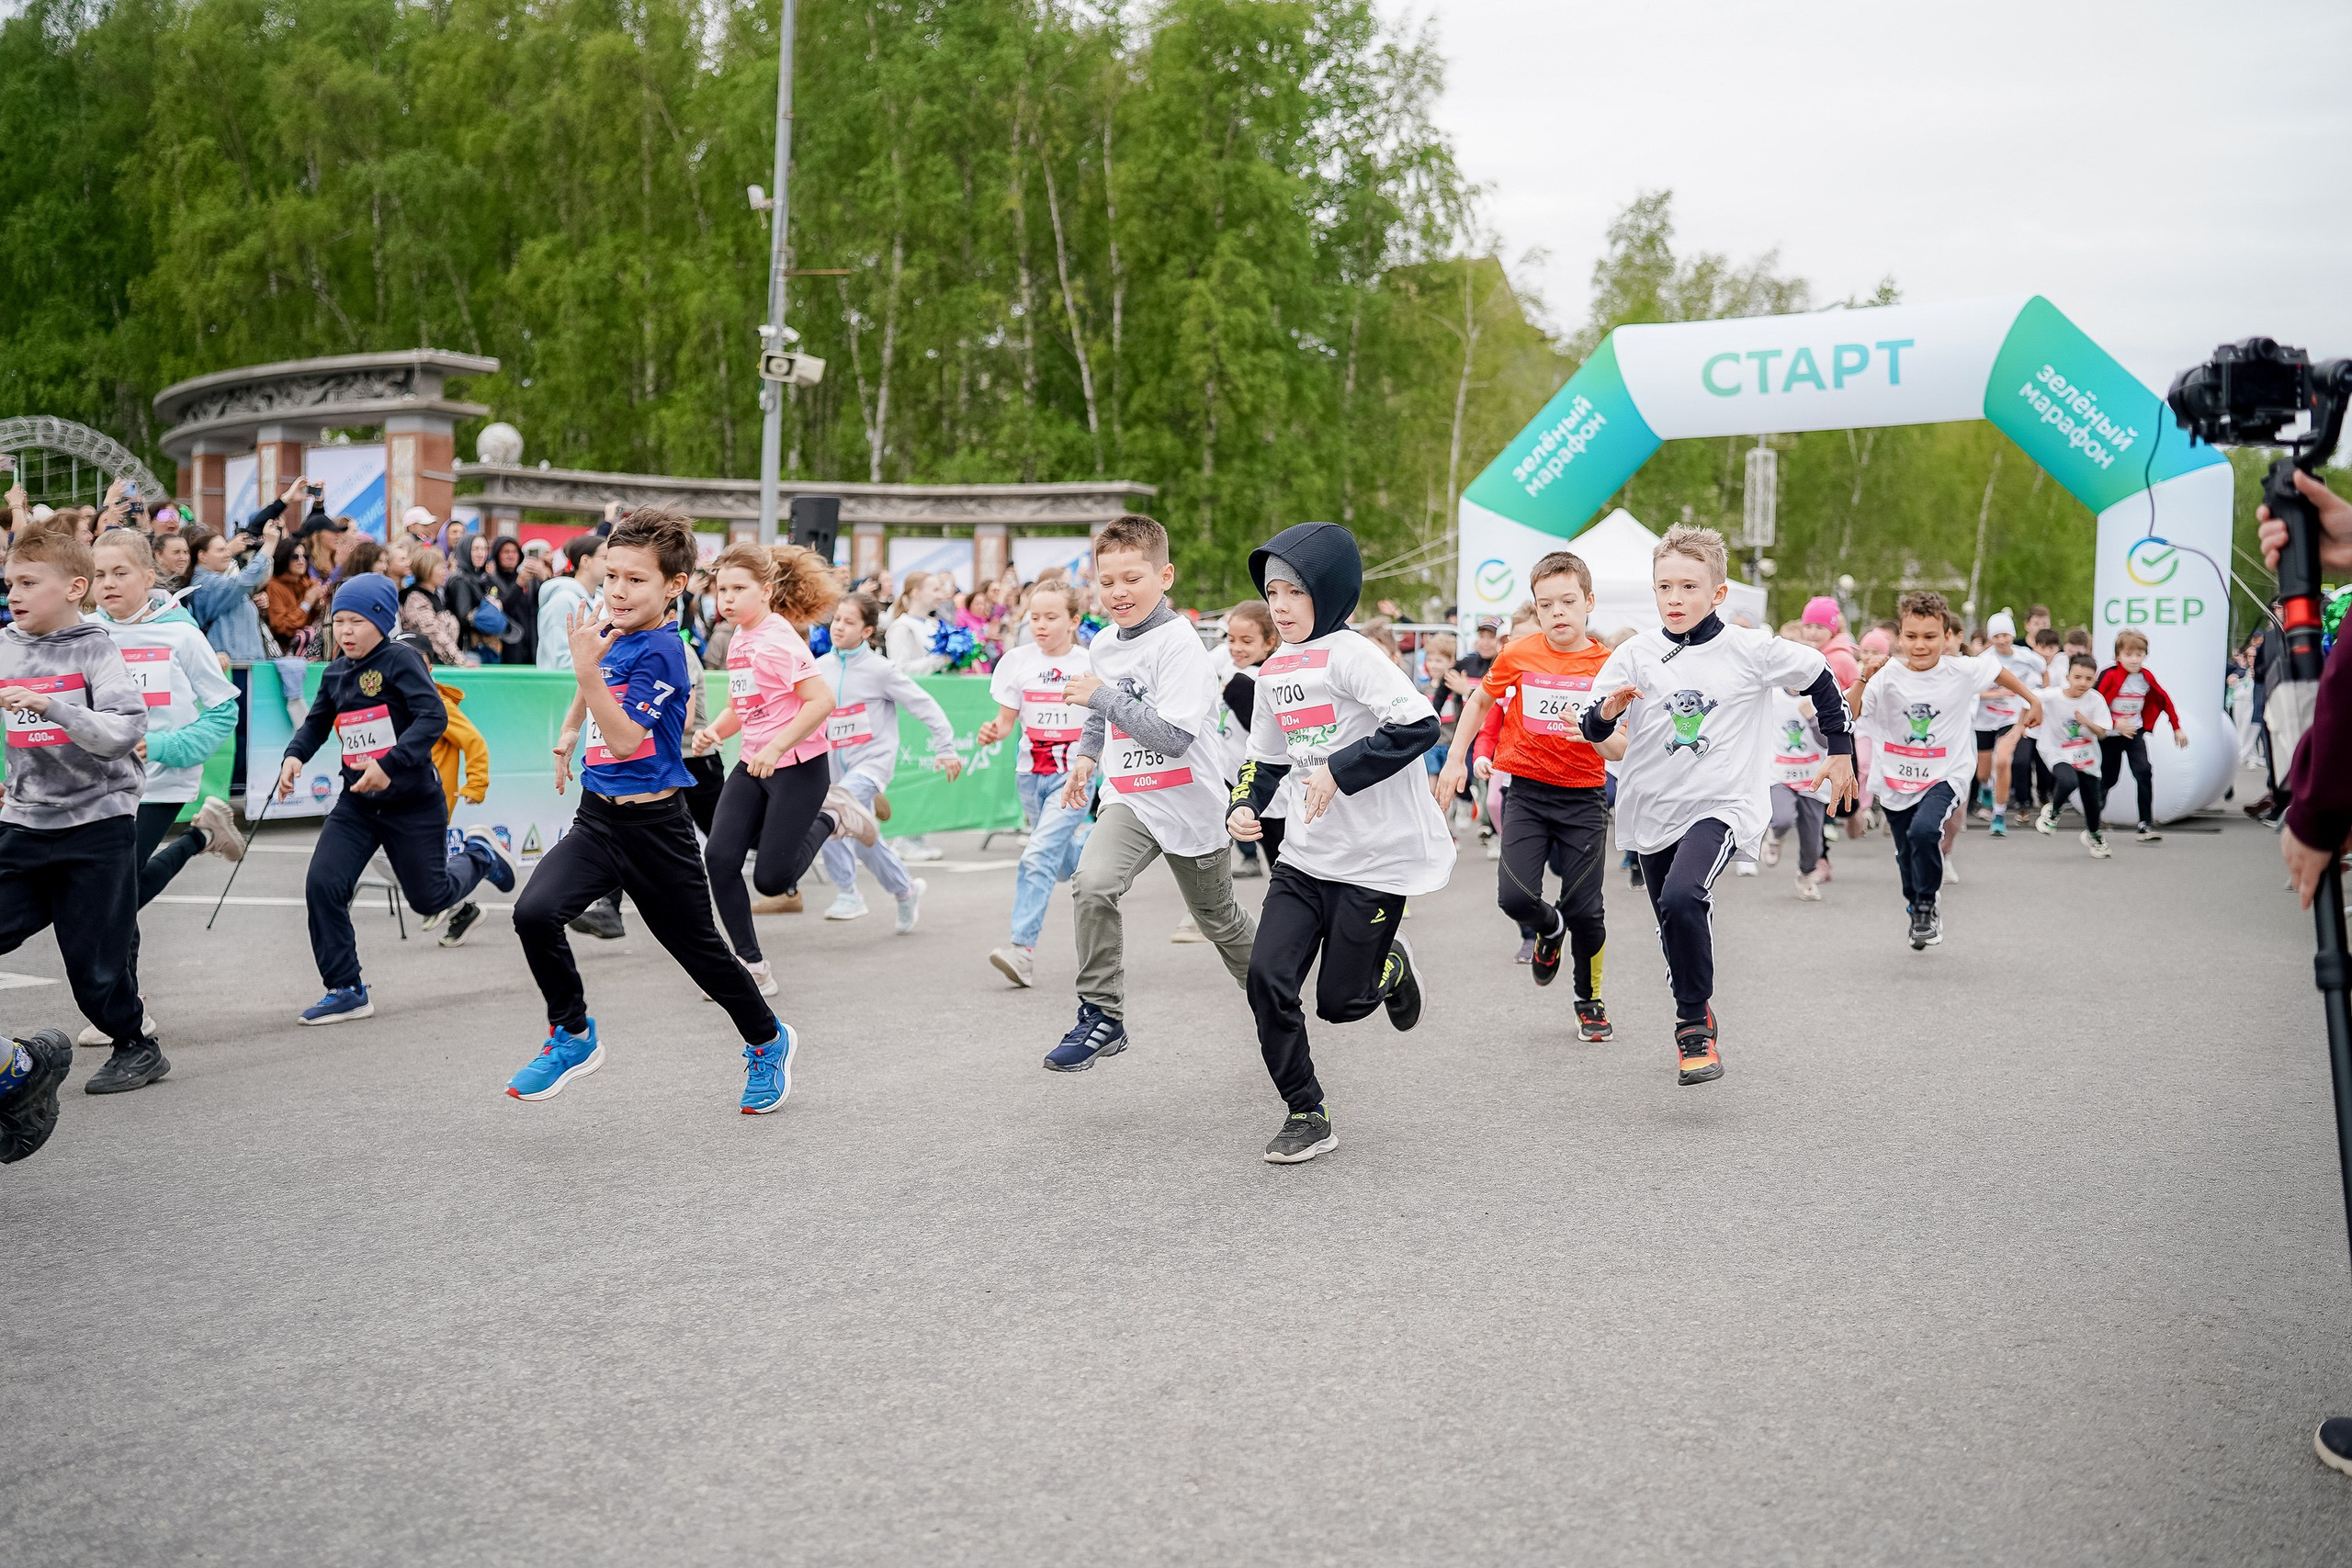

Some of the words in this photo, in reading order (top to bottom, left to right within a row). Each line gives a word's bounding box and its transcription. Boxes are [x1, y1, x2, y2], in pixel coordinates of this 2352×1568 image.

[1702, 339, 1915, 398] СТАРТ
[2036, 364, 2139, 453] зелёный
[2018, 381, 2114, 470] марафон
[1512, 394, 1593, 483] зелёный
[1525, 412, 1607, 498] марафон
[2104, 597, 2204, 625] СБЕР
[653, 680, 675, 706] 7
[17, 708, 49, 725] 28
[1037, 713, 1068, 725] 2711
[28, 731, 55, 742] 400м
[347, 733, 376, 750] 2614
[1123, 750, 1164, 770] 2758
[1899, 764, 1929, 778] 2814
[1133, 775, 1158, 787] 400м
